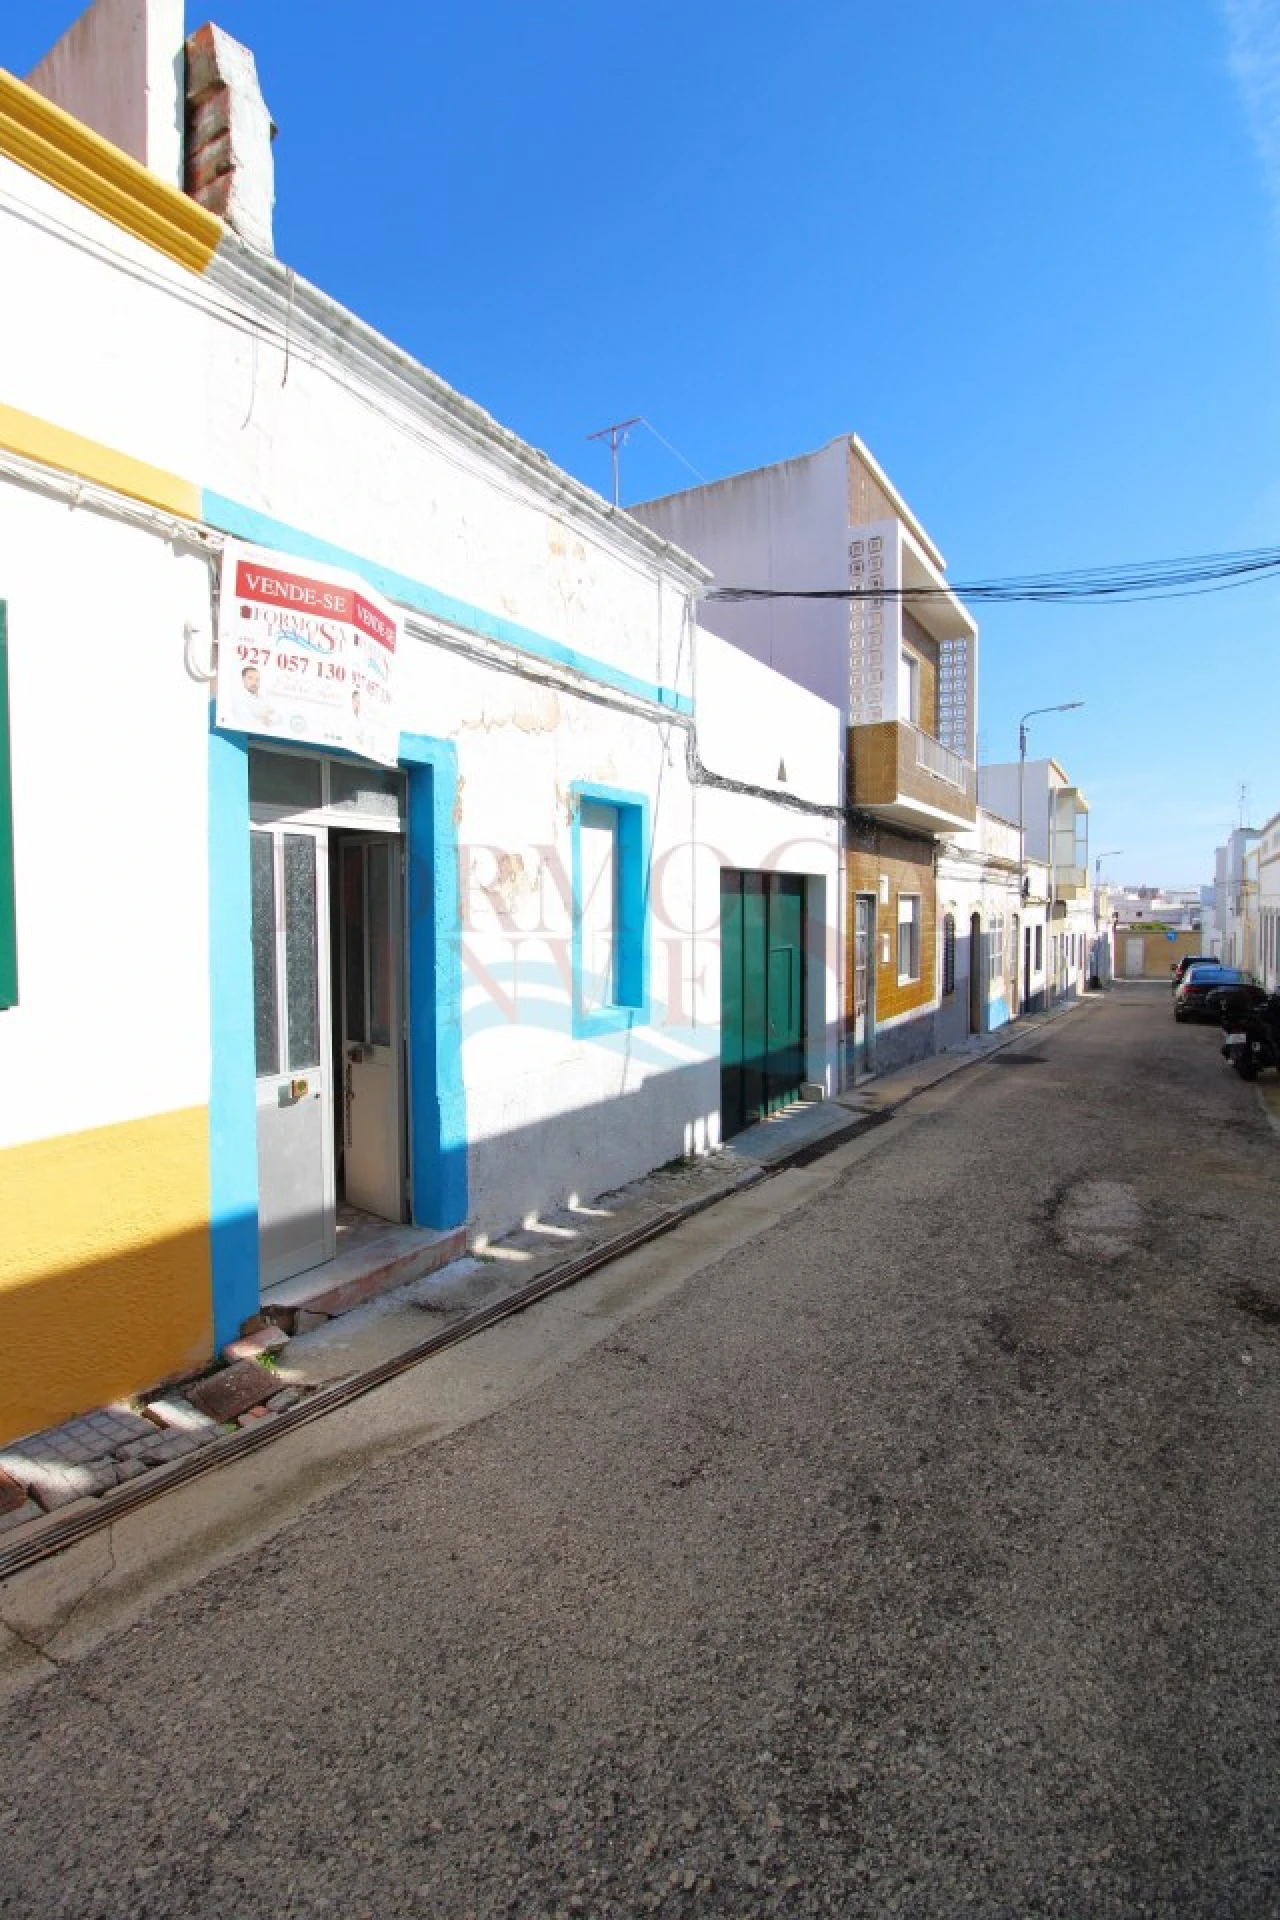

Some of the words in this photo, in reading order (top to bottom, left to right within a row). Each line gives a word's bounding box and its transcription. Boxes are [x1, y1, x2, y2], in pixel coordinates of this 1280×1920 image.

[244, 572, 347, 613] VENDE-SE
[236, 645, 271, 667] 927
[277, 653, 309, 675] 057
[317, 661, 346, 682] 130
